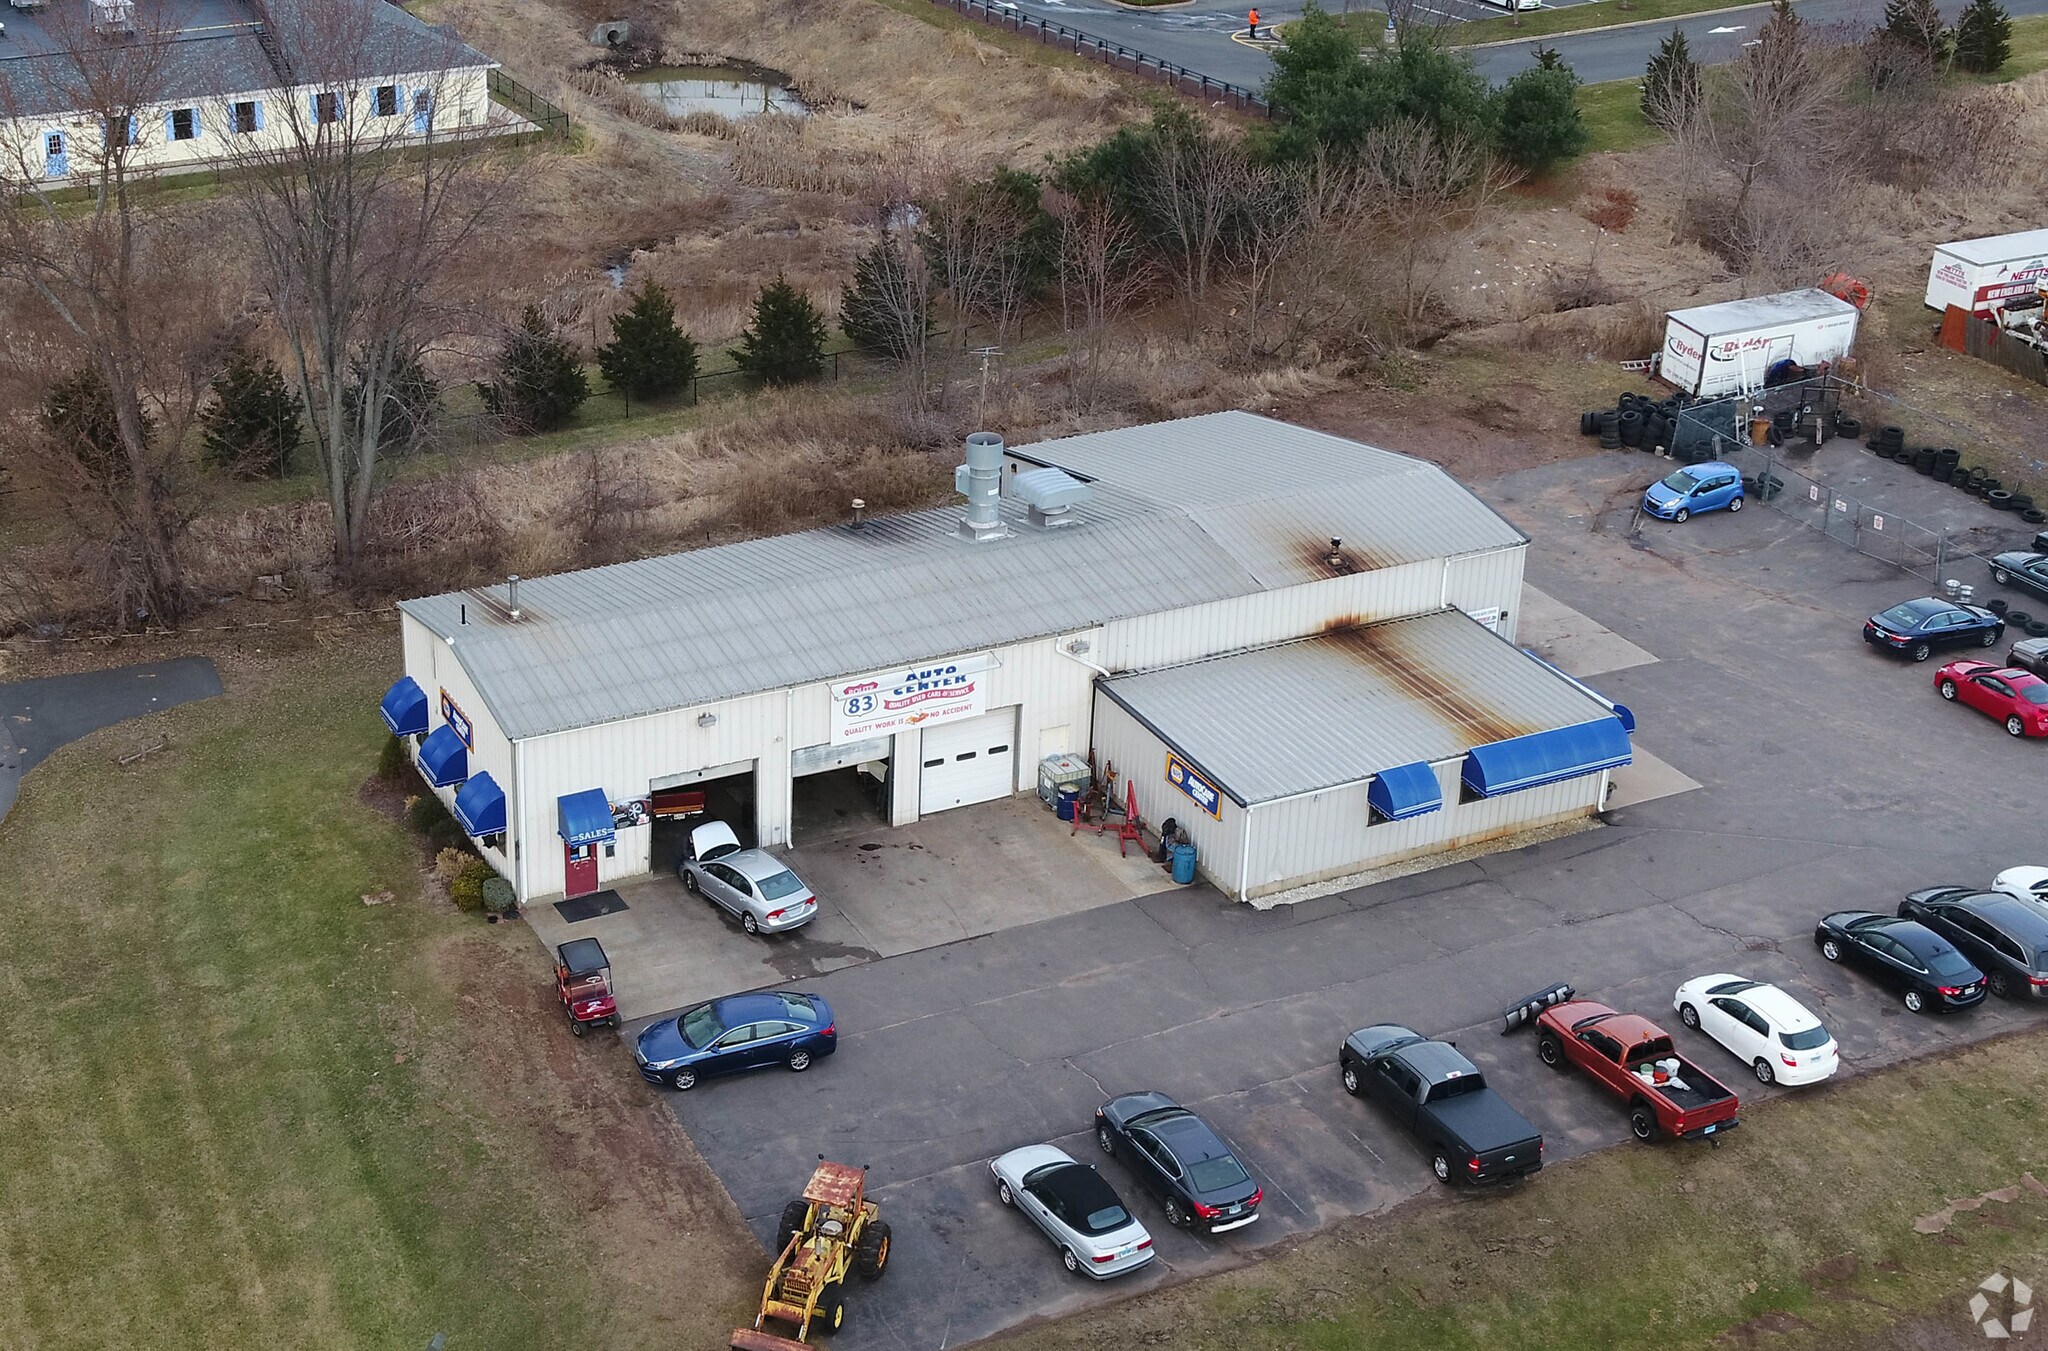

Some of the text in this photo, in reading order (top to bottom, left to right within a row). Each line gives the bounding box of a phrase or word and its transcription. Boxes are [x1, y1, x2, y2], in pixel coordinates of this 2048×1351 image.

[1676, 339, 1703, 361] Ryder
[905, 665, 957, 682] AUTO
[893, 674, 967, 696] CENTER
[848, 695, 873, 714] 83
[888, 699, 911, 709] QUALITY
[911, 692, 926, 703] USED
[927, 690, 941, 698] CARS
[949, 687, 970, 696] SERVICE
[844, 724, 873, 736] QUALITY
[875, 719, 897, 729] WORK
[930, 710, 940, 718] NO
[942, 703, 973, 716] ACCIDENT
[578, 828, 608, 841] SALES
